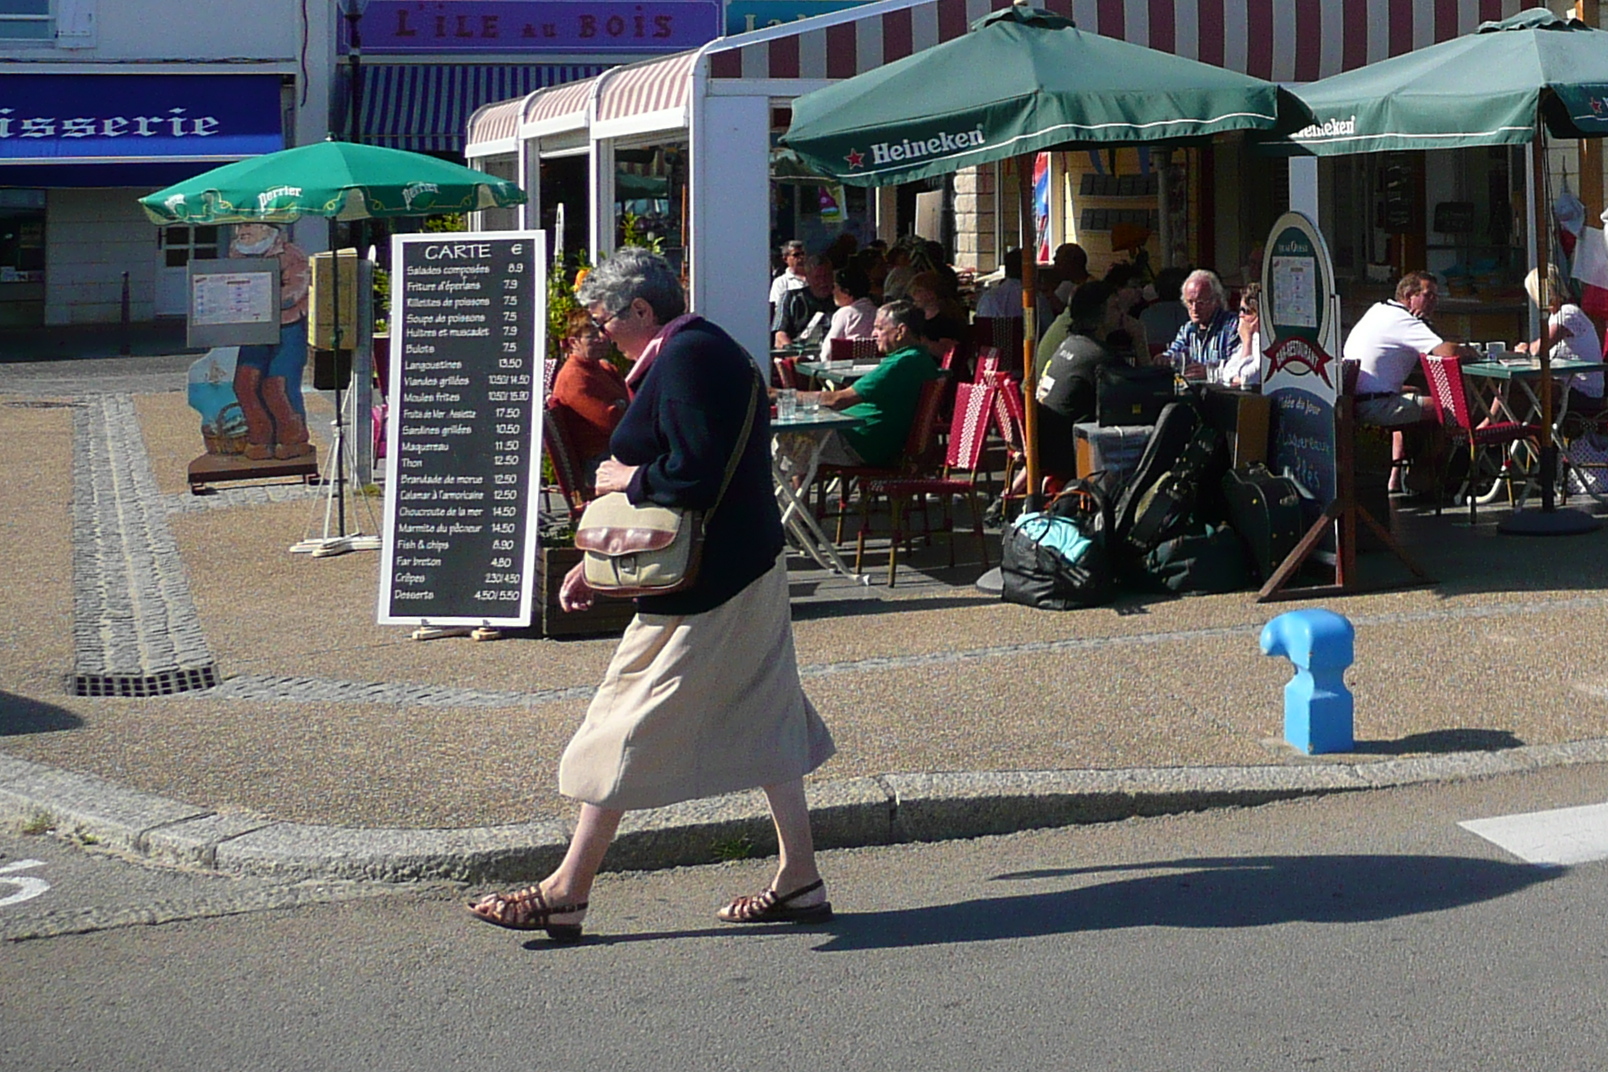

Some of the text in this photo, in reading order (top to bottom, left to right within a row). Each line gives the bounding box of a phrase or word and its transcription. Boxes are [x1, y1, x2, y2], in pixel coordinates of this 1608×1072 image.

[0, 108, 220, 139] isserie
[1287, 117, 1355, 138] eineken
[870, 127, 986, 165] Heineken
[424, 243, 523, 260] CARTE €
[406, 262, 524, 277] Salades composées 8.9
[406, 281, 436, 292] Friture
[442, 297, 453, 307] de
[454, 297, 490, 309] poissons
[434, 313, 446, 323] de
[446, 314, 486, 326] poissons
[438, 327, 448, 337] et
[449, 326, 490, 337] muscadet
[405, 343, 436, 354] Bulots
[404, 359, 463, 372] Langoustines
[403, 376, 438, 387] Viandes
[438, 375, 470, 388] grillées
[403, 392, 435, 403] Moules
[435, 391, 461, 402] frites
[402, 425, 441, 436] Sardines
[441, 424, 473, 438] grillées
[401, 441, 450, 455] Maquereau
[401, 457, 423, 468] Thon
[400, 473, 442, 485] Brandade
[443, 474, 455, 484] de
[456, 475, 484, 485] morue
[399, 506, 446, 518] Choucroute
[446, 506, 457, 517] de
[458, 505, 466, 516] la
[466, 507, 484, 517] mer
[398, 522, 436, 534] Marmite
[436, 523, 448, 533] du
[397, 539, 417, 550] Fish
[417, 539, 425, 550] &
[426, 539, 450, 553] chips
[396, 556, 412, 566] Far
[412, 556, 442, 567] breton
[394, 572, 426, 586] Crêpes
[394, 589, 435, 601] Desserts
